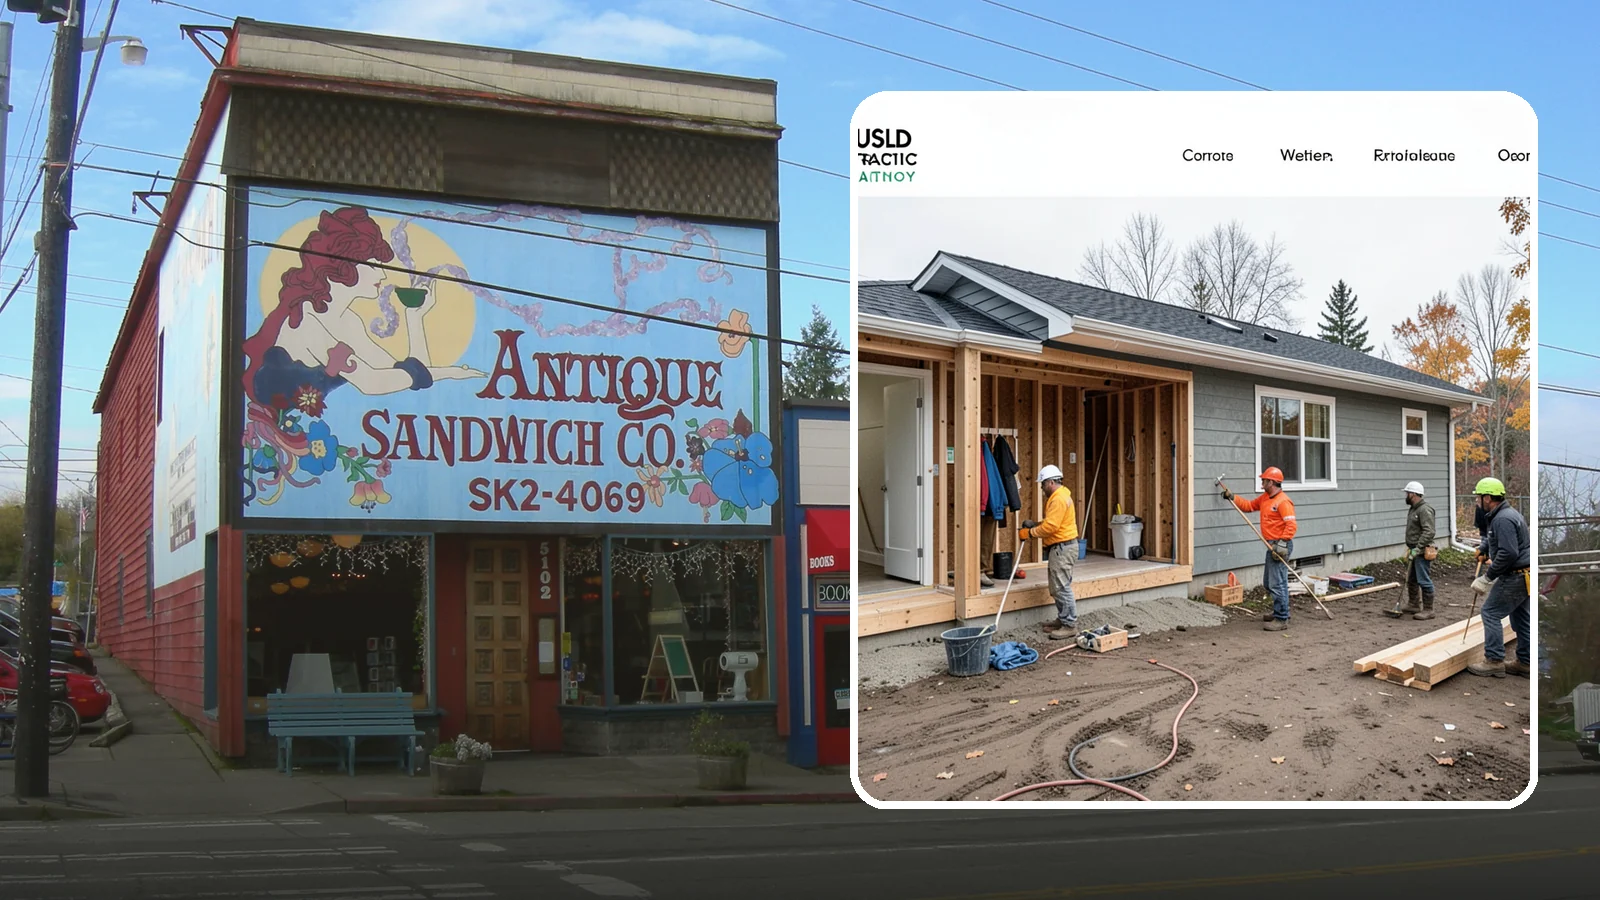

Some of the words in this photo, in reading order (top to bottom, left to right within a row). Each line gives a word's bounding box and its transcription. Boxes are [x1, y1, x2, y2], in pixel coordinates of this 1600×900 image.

[477, 329, 723, 420] ANTIQUE
[362, 408, 604, 467] SANDWICH
[617, 421, 684, 468] CO.
[469, 477, 645, 513] SK2-4069
[540, 542, 552, 599] 5102
[809, 555, 835, 569] BOOKS
